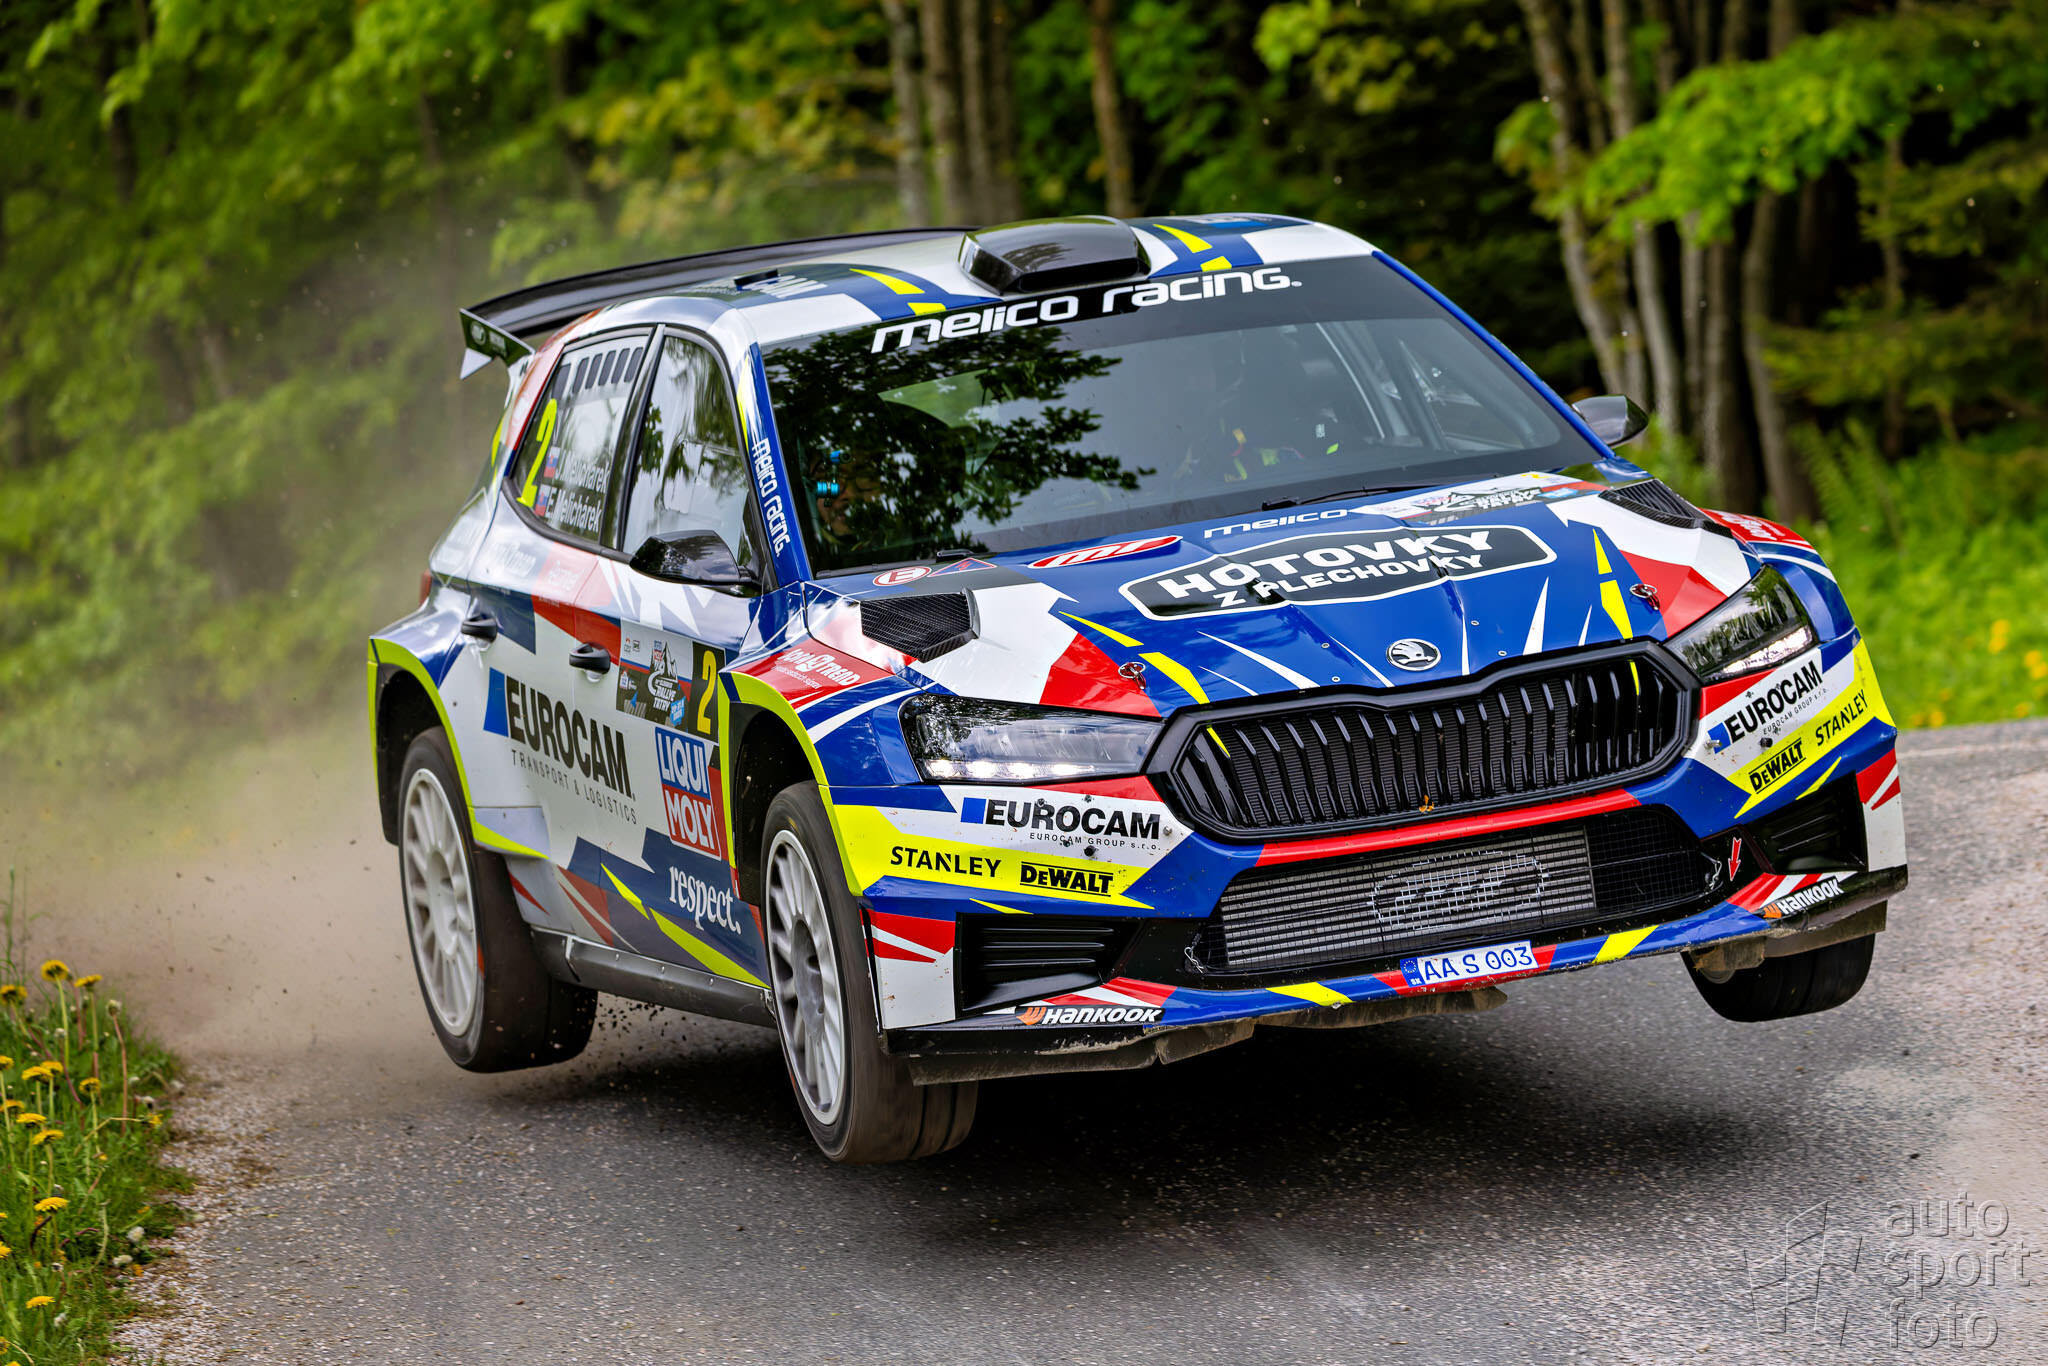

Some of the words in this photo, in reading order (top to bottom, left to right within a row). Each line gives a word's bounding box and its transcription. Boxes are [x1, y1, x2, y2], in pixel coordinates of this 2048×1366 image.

[870, 295, 1079, 354] melico
[516, 397, 557, 508] 2
[752, 437, 778, 498] melico
[1203, 508, 1348, 538] melico
[1157, 530, 1491, 598] HOTOVKY
[1213, 590, 1246, 607] Z
[1252, 554, 1486, 598] PLECHOVKY
[697, 650, 717, 735] 2
[1724, 660, 1823, 744] EUROCAM
[1763, 711, 1793, 736] EUROCAM
[1795, 697, 1814, 714] GROUP
[1815, 689, 1868, 747] STANLEY
[512, 749, 570, 790] TRANSPORT
[584, 784, 637, 824] LOGISTICS
[657, 732, 708, 794] LIQUI
[665, 789, 715, 850] MOLY
[985, 798, 1160, 839] EUROCAM
[1029, 832, 1082, 845] EUROCAM
[1088, 838, 1126, 848] GROUP
[1130, 842, 1161, 851] s.r.o.
[890, 846, 1002, 878] STANLEY
[669, 865, 741, 935] respect.
[1424, 957, 1460, 981] AA
[1462, 953, 1480, 974] S
[1485, 946, 1533, 970] 003
